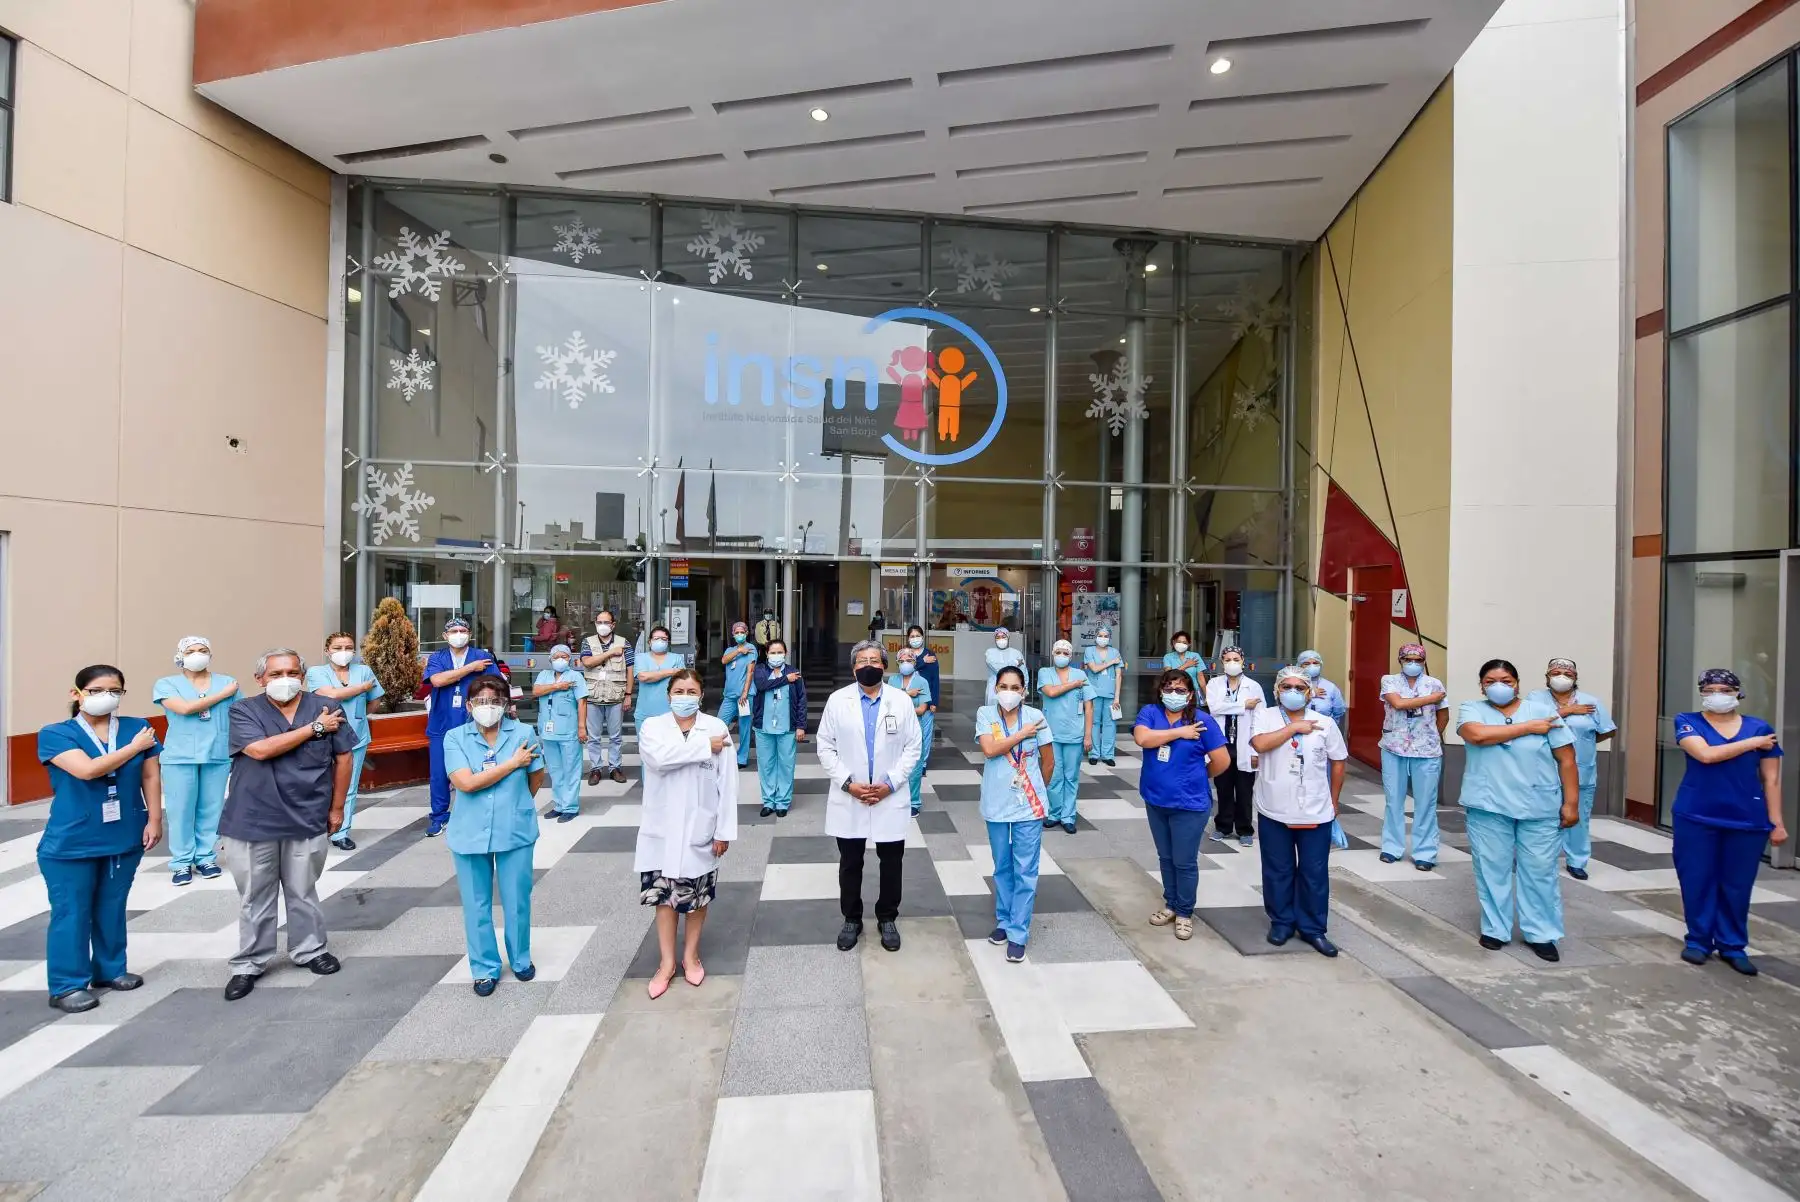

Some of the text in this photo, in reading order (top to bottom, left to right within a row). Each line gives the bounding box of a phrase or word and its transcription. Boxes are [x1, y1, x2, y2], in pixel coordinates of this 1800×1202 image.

[704, 330, 879, 411] insn
[806, 414, 836, 424] Salud
[837, 415, 851, 424] del
[829, 426, 878, 438] San Borja
